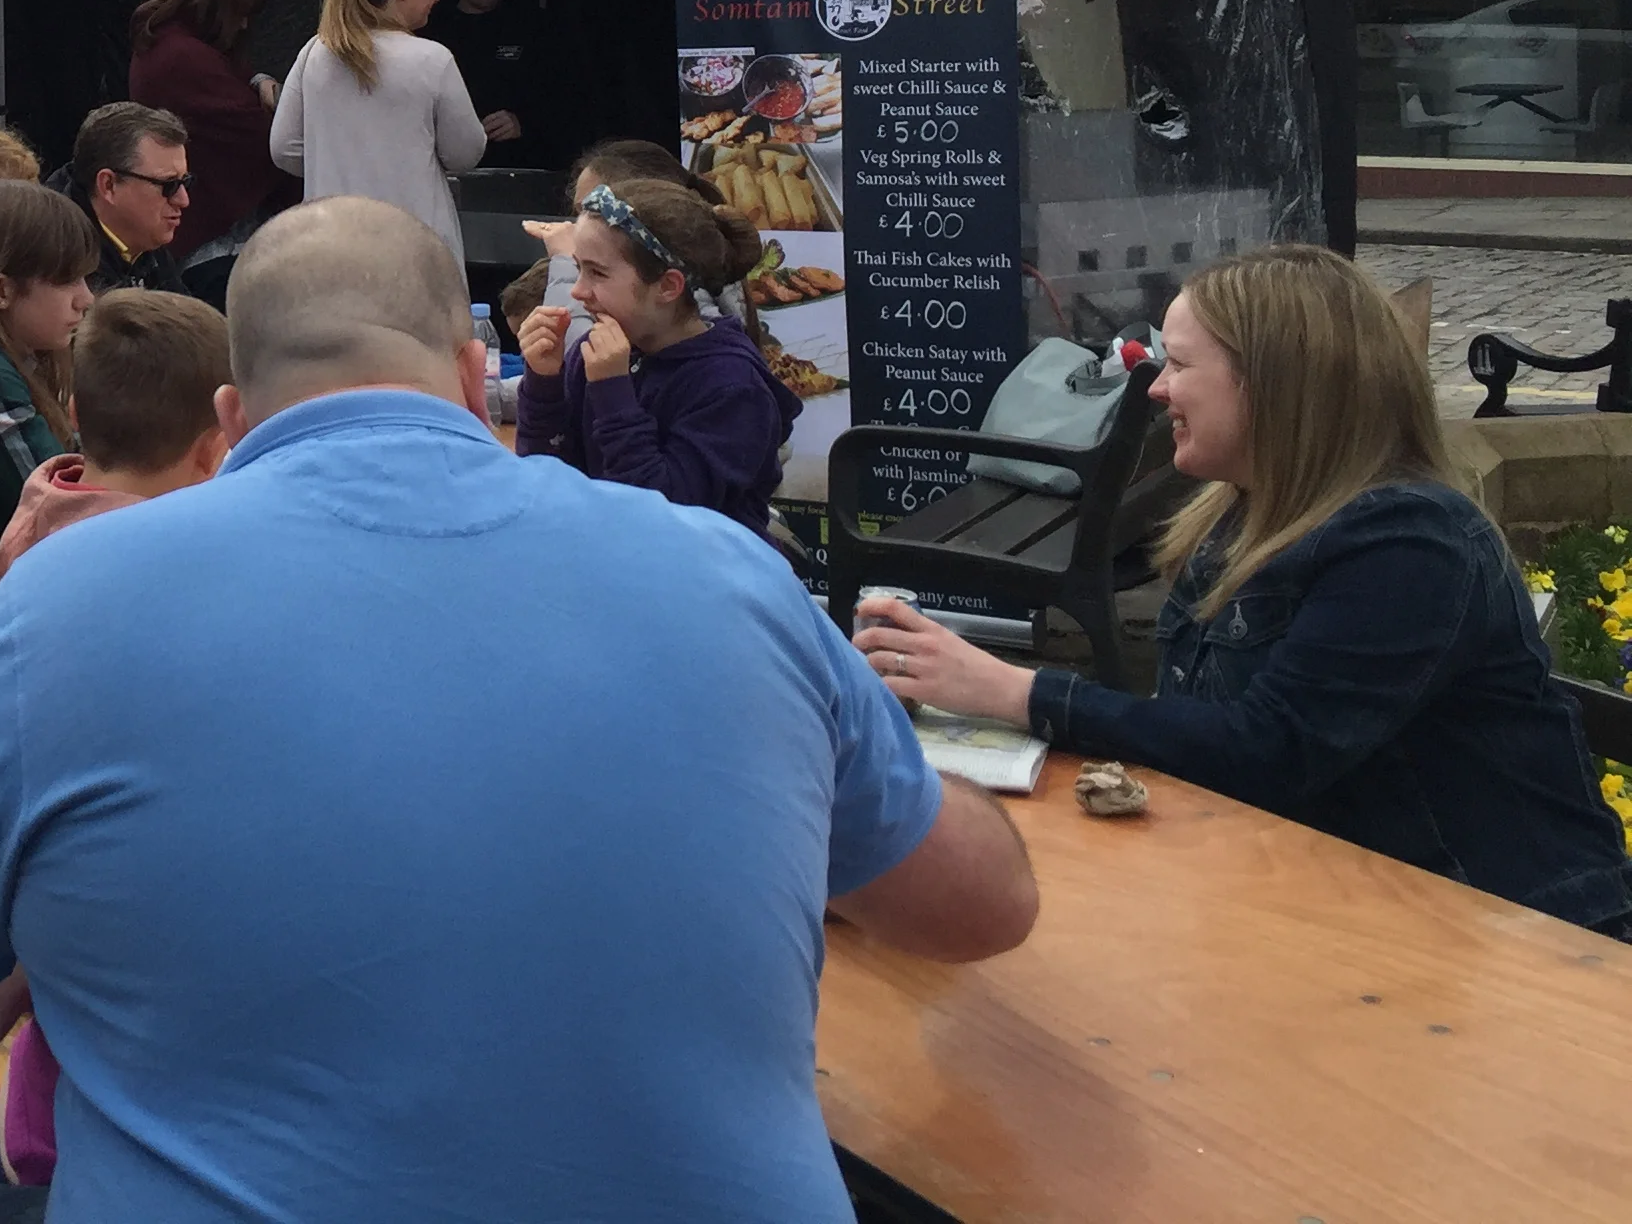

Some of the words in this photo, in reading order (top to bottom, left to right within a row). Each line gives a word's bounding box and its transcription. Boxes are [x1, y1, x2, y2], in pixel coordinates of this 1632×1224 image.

[859, 59, 906, 74] Mixed
[910, 60, 961, 74] Starter
[965, 58, 1000, 72] with
[853, 82, 894, 95] sweet
[898, 80, 939, 95] Chilli
[944, 81, 989, 94] Sauce
[992, 81, 1006, 94] &
[880, 103, 931, 116] Peanut
[935, 102, 979, 116] Sauce
[860, 150, 888, 167] Veg
[892, 150, 941, 168] Spring
[945, 150, 983, 164] Rolls
[987, 151, 1002, 164] &
[856, 171, 920, 186] Samosa's
[925, 171, 958, 186] with
[963, 174, 1006, 187] sweet
[886, 193, 928, 208] Chilli
[932, 194, 976, 208] Sauce
[854, 250, 887, 266] Thai
[891, 251, 922, 266] Fish
[926, 252, 972, 268] Cakes
[976, 253, 1012, 268] with
[869, 273, 949, 289] Cucumber
[953, 275, 1001, 290] Relish
[862, 342, 924, 359] Chicken
[929, 344, 968, 363] Satay
[972, 346, 1007, 363] with
[885, 365, 936, 381] Peanut
[940, 368, 984, 384] Sauce
[945, 450, 962, 462] or
[873, 464, 904, 480] with
[906, 466, 967, 484] Jasmine
[918, 589, 946, 608] any
[949, 592, 993, 611] event.
